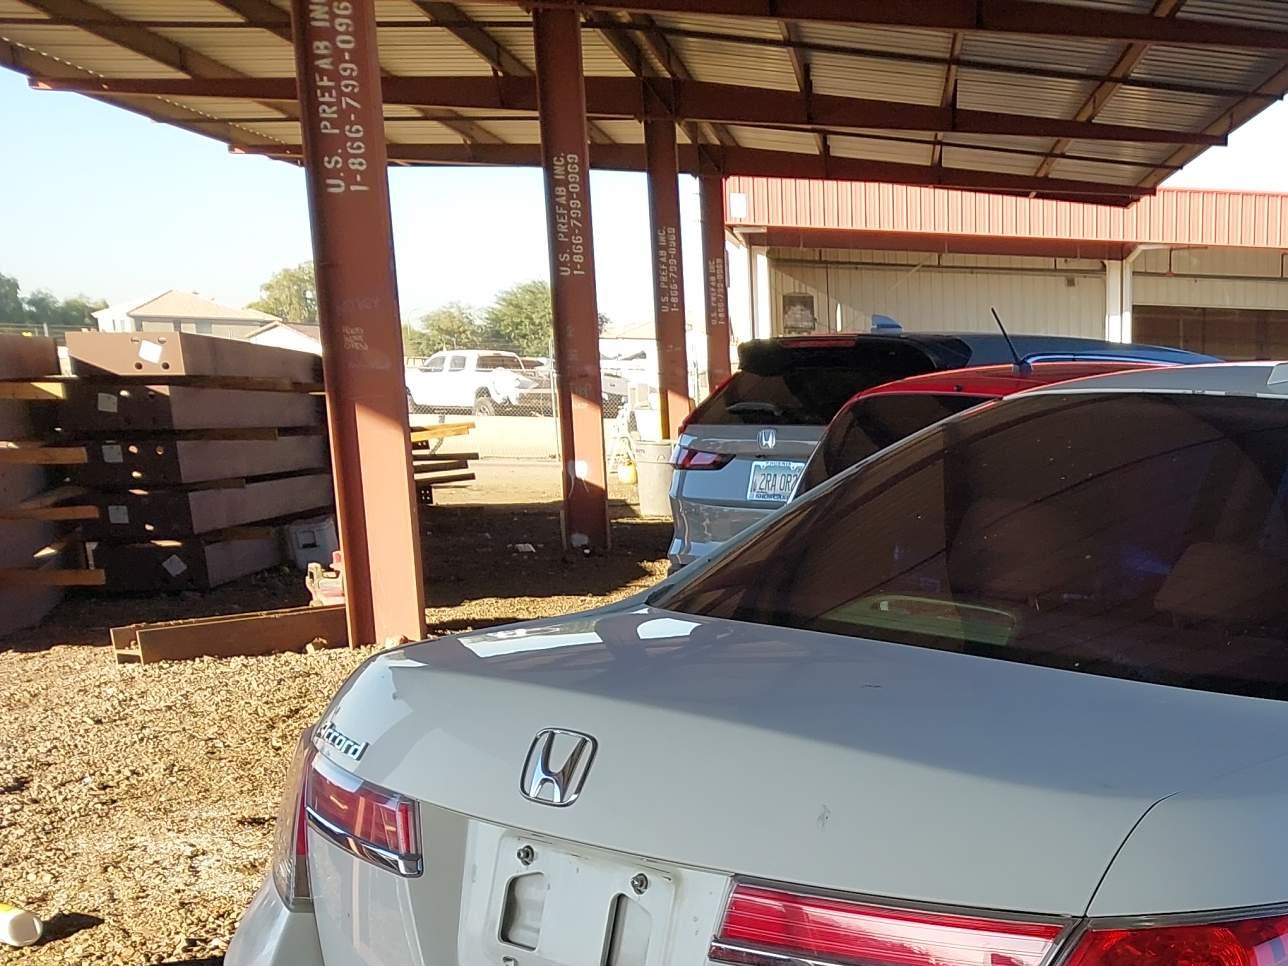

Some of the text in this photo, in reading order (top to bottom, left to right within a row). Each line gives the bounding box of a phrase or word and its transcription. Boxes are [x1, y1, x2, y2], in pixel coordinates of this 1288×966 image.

[308, 0, 346, 193] U.S. PREFAB IN
[552, 152, 571, 276] U.S. PREFAB INC.
